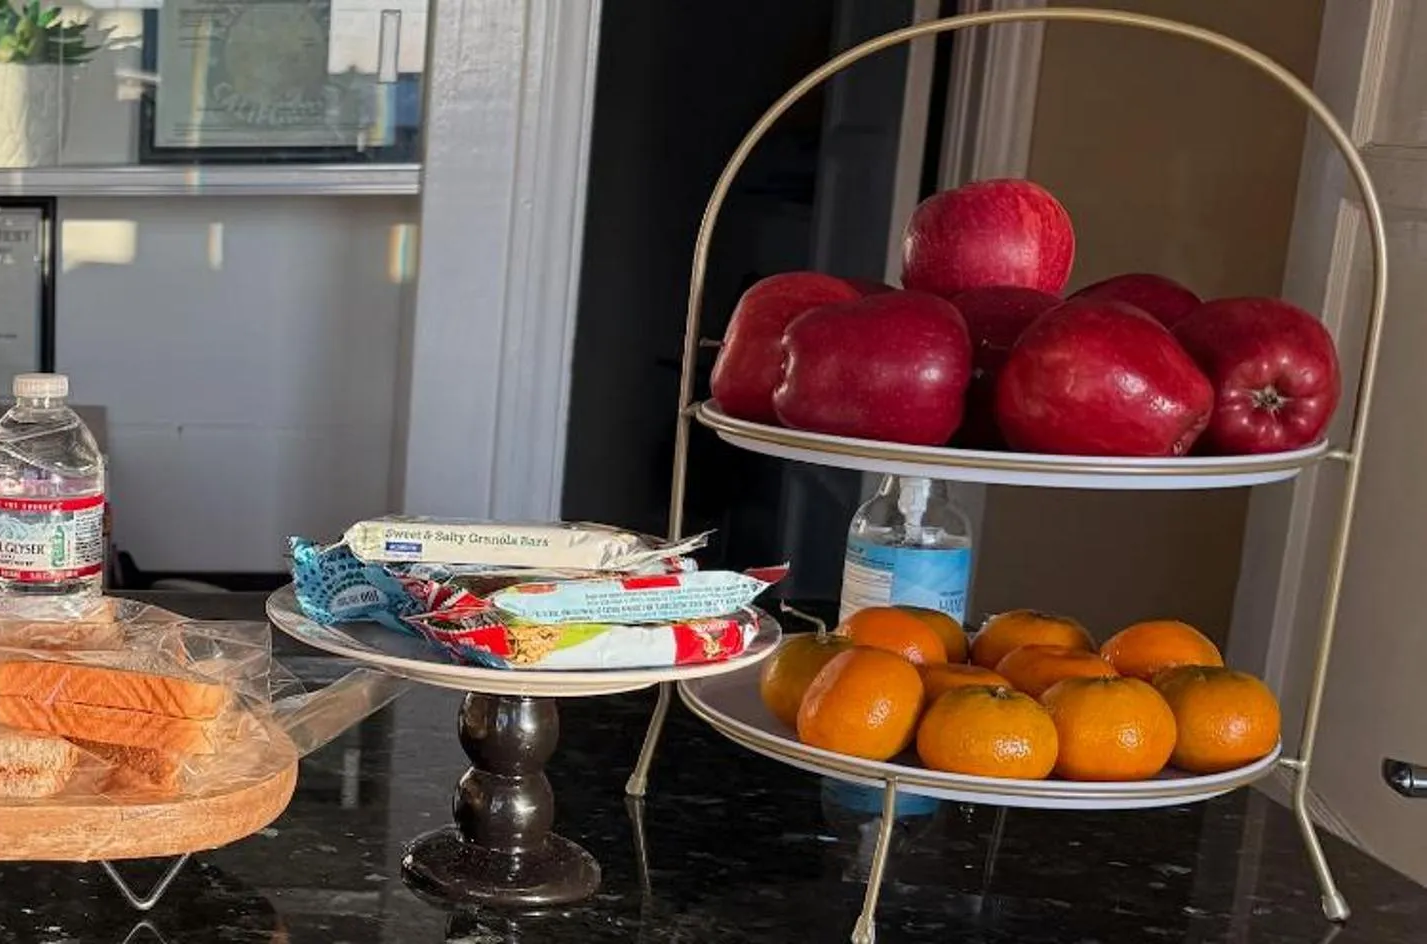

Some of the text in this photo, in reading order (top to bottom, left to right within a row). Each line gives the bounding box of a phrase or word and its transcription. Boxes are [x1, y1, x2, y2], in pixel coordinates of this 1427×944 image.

[385, 529, 549, 547] Sweet & Salty Granola Bars
